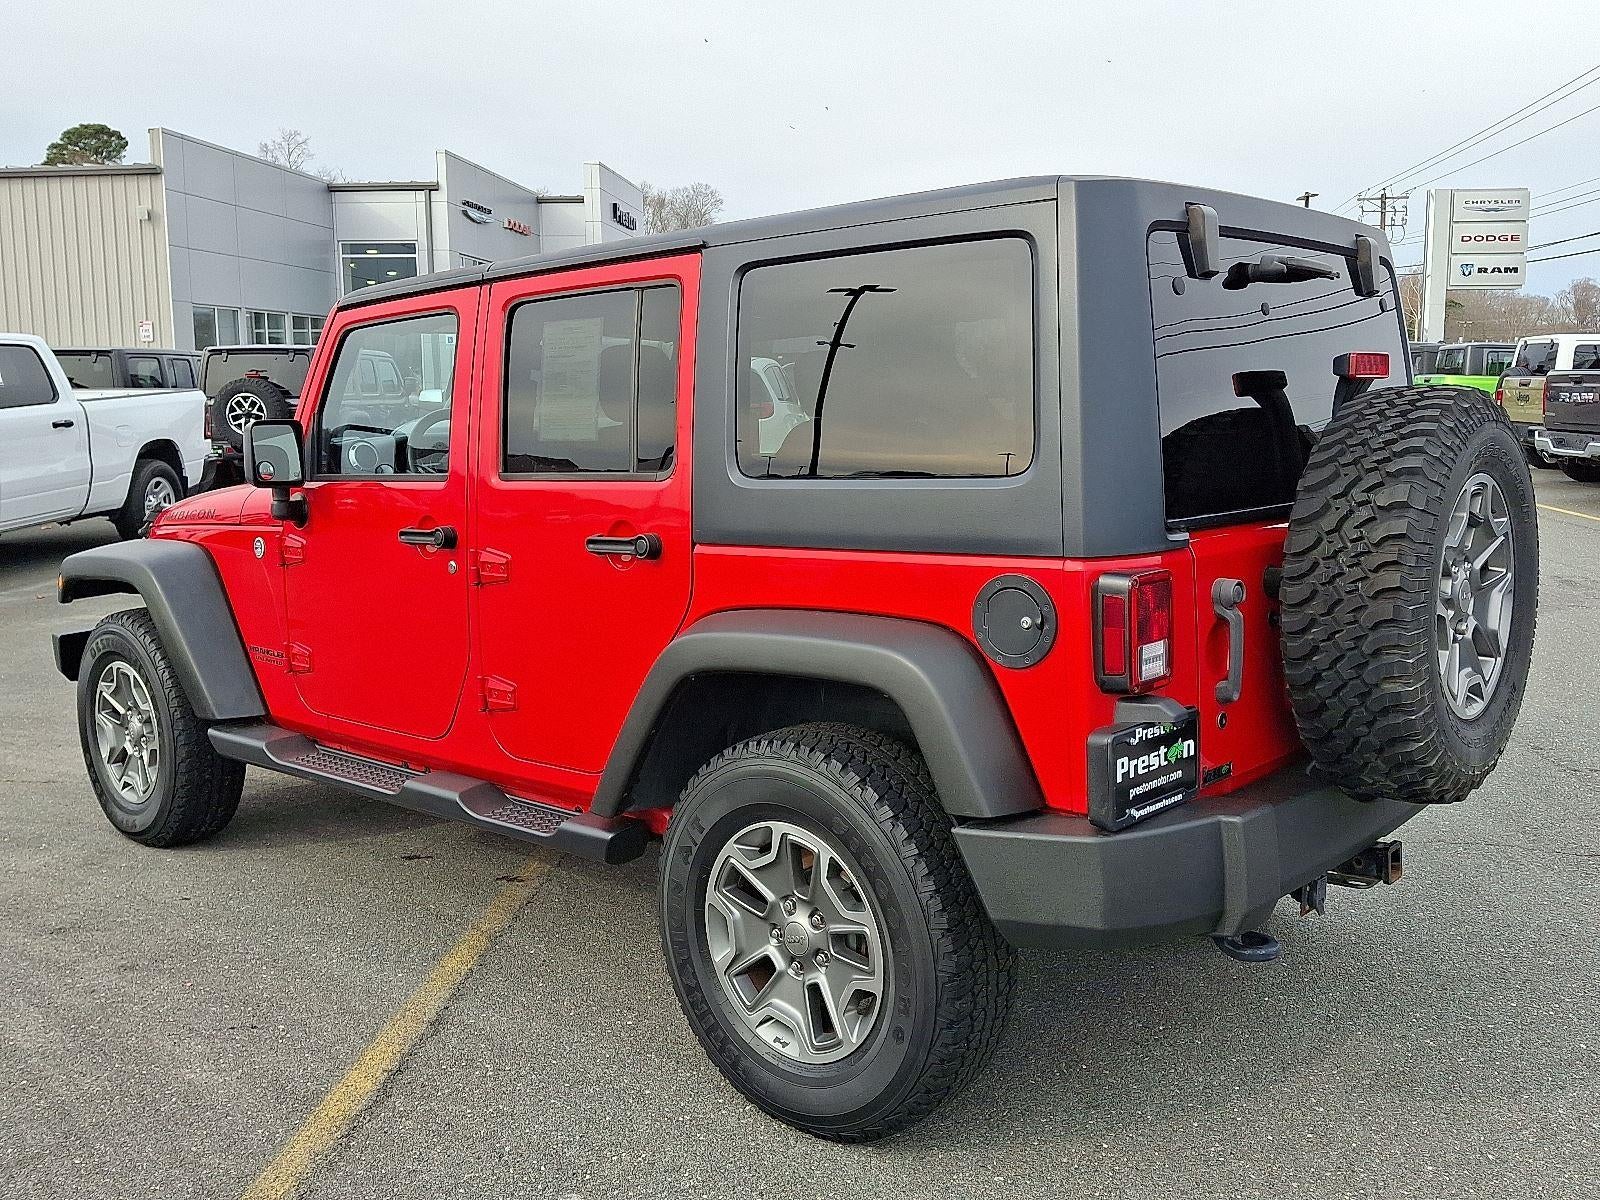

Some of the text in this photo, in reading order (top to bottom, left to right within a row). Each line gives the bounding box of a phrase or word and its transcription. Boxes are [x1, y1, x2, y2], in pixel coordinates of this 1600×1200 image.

[1460, 234, 1521, 243] DODGE
[1477, 266, 1519, 274] RAM
[1116, 738, 1195, 784] Preston
[1129, 769, 1183, 801] prestonmotor.com
